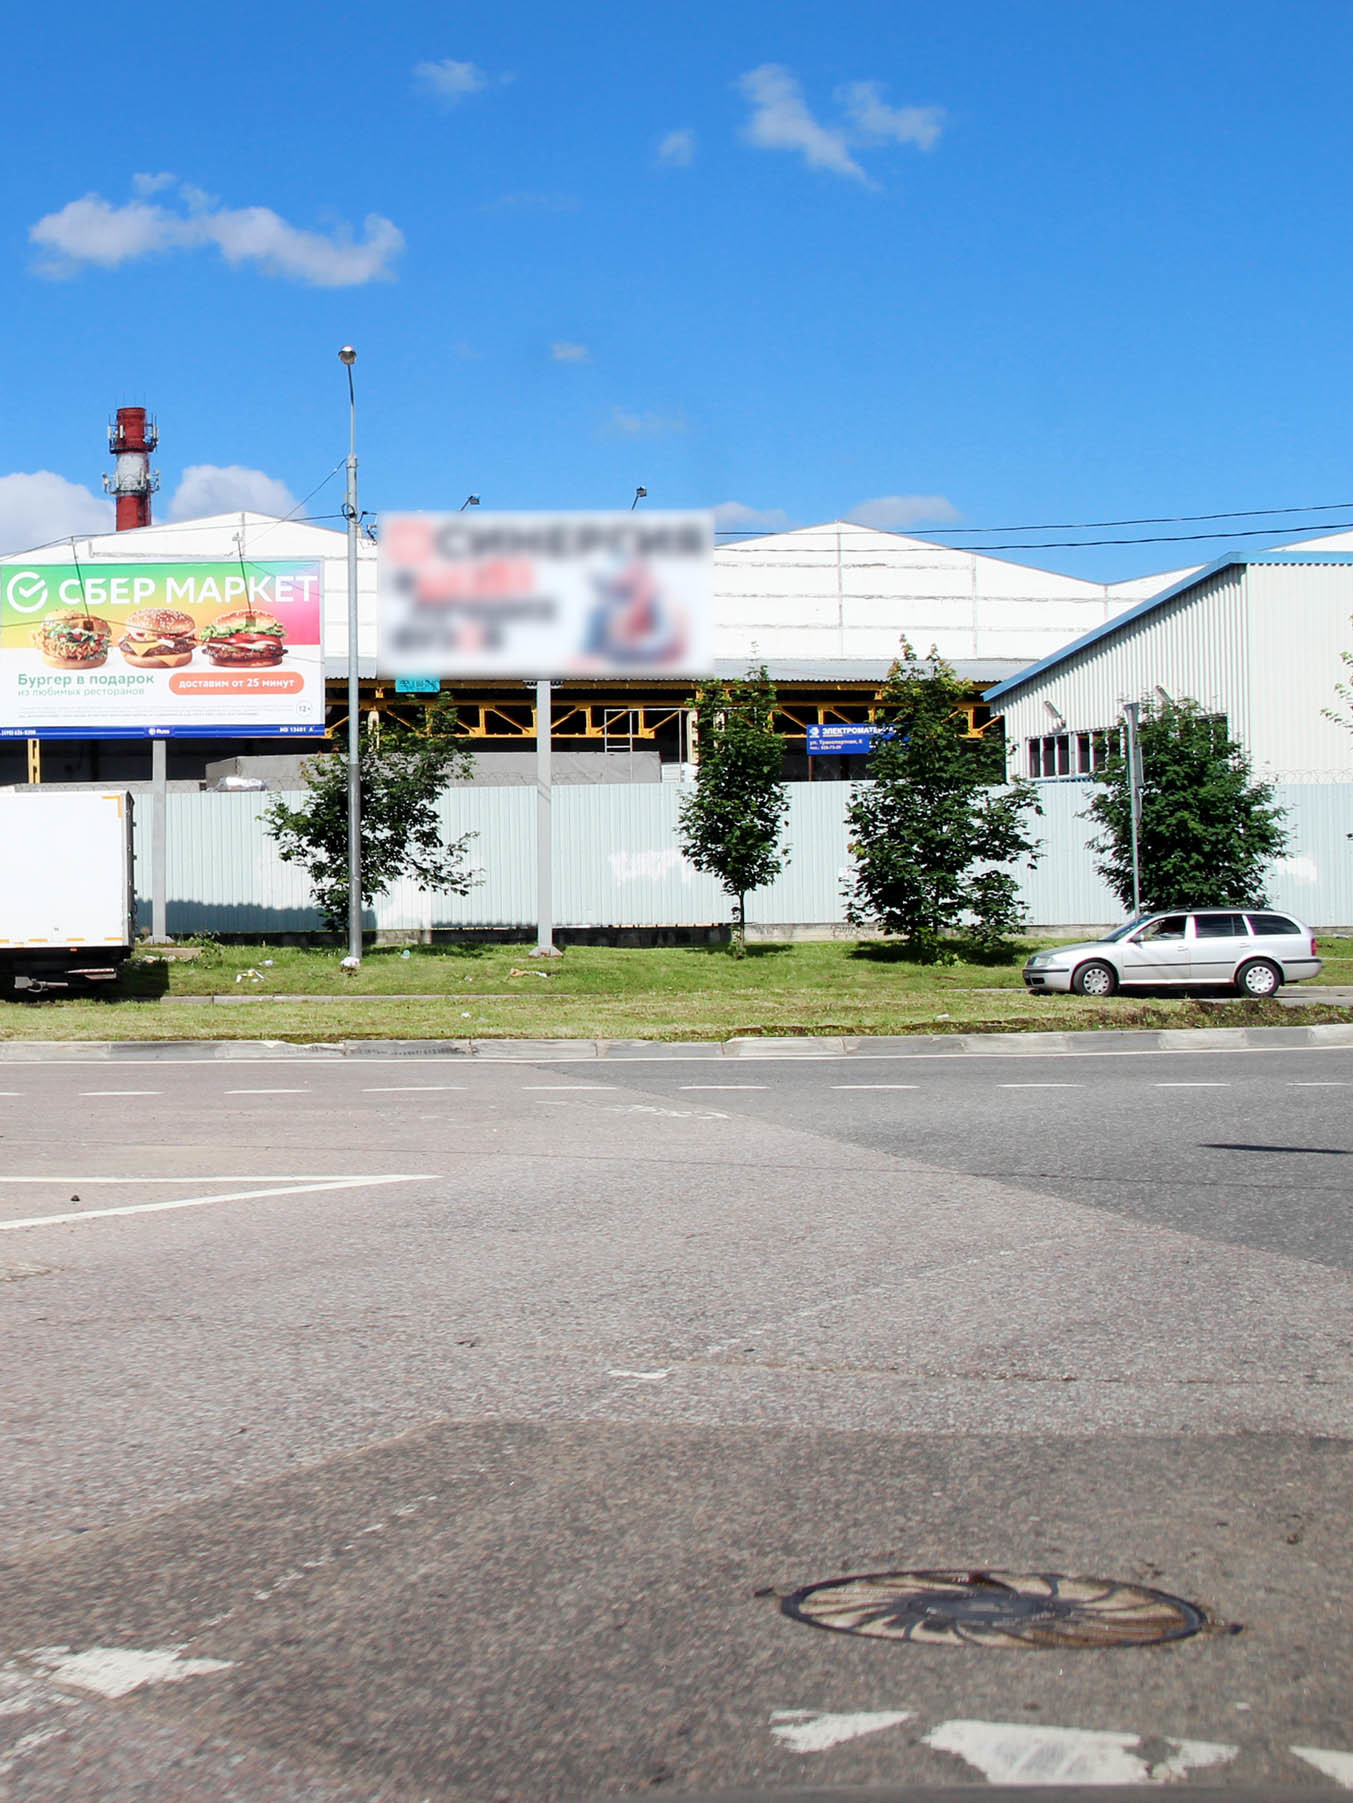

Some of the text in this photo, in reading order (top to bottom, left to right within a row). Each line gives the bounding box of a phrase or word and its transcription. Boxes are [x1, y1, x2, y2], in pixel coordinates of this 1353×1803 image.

[58, 575, 319, 606] СБЕР МАРКЕТ
[17, 674, 155, 688] Бургер в подарок
[178, 680, 229, 689] доставим
[246, 678, 260, 687] 25
[262, 679, 295, 689] минут
[17, 686, 145, 697] из любимых ресторанов
